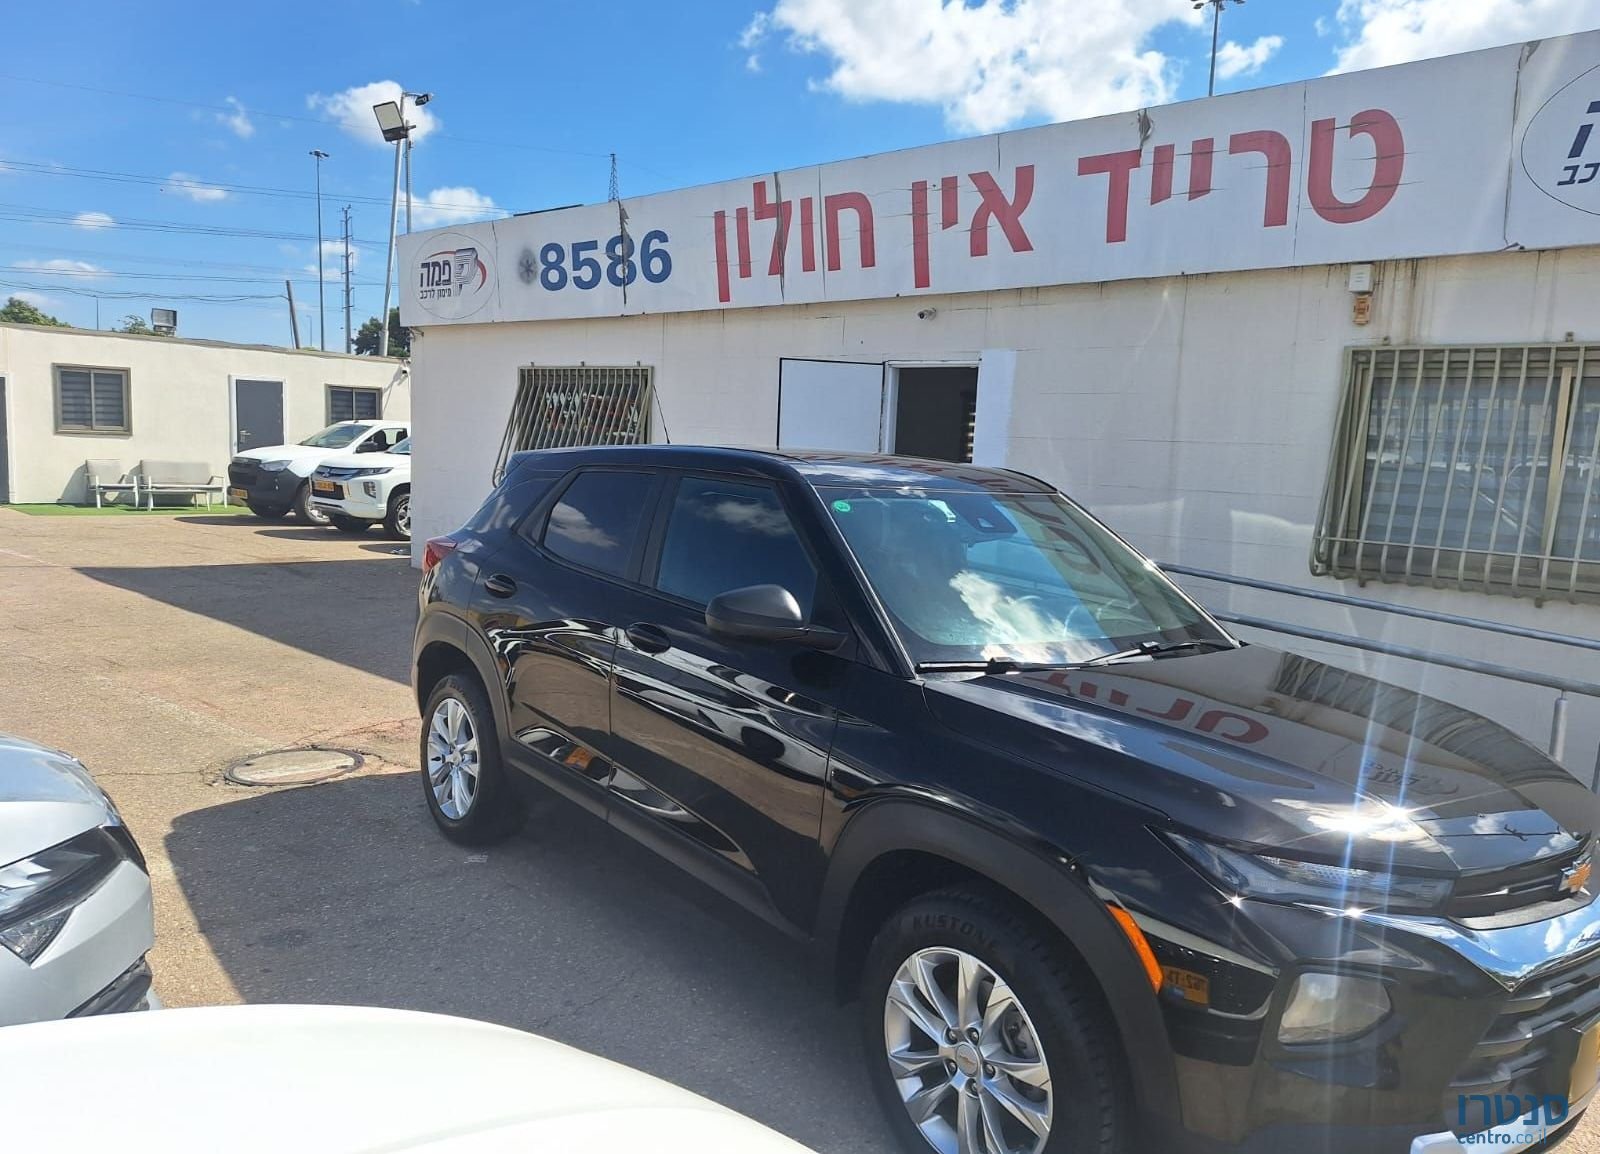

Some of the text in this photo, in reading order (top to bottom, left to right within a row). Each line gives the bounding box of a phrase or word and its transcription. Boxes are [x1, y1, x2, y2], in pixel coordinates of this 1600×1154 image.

[713, 107, 1405, 303] טרייד אין חולון
[419, 259, 452, 288] פמה
[419, 289, 435, 300] לרכב
